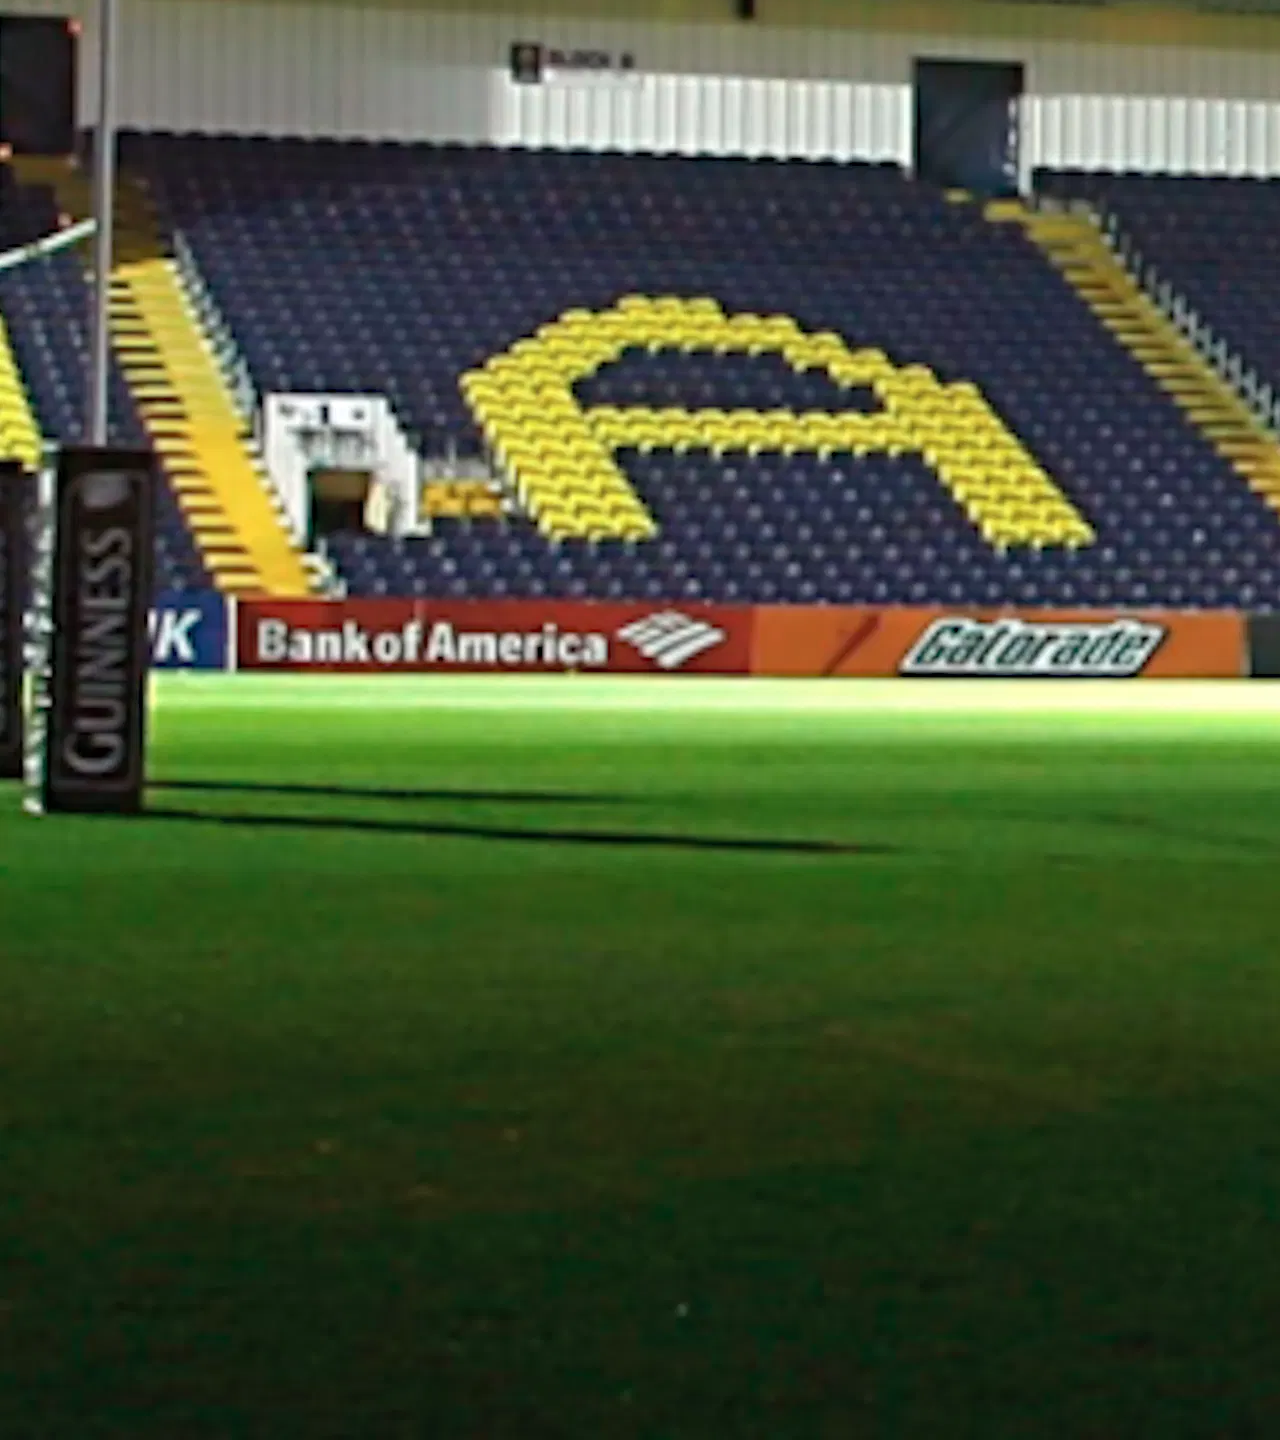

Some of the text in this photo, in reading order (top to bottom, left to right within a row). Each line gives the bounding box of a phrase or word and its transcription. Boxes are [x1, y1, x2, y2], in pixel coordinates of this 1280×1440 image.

[64, 525, 132, 774] GUINNESS
[256, 615, 609, 664] Bank of America
[908, 617, 1156, 669] Gatorade
